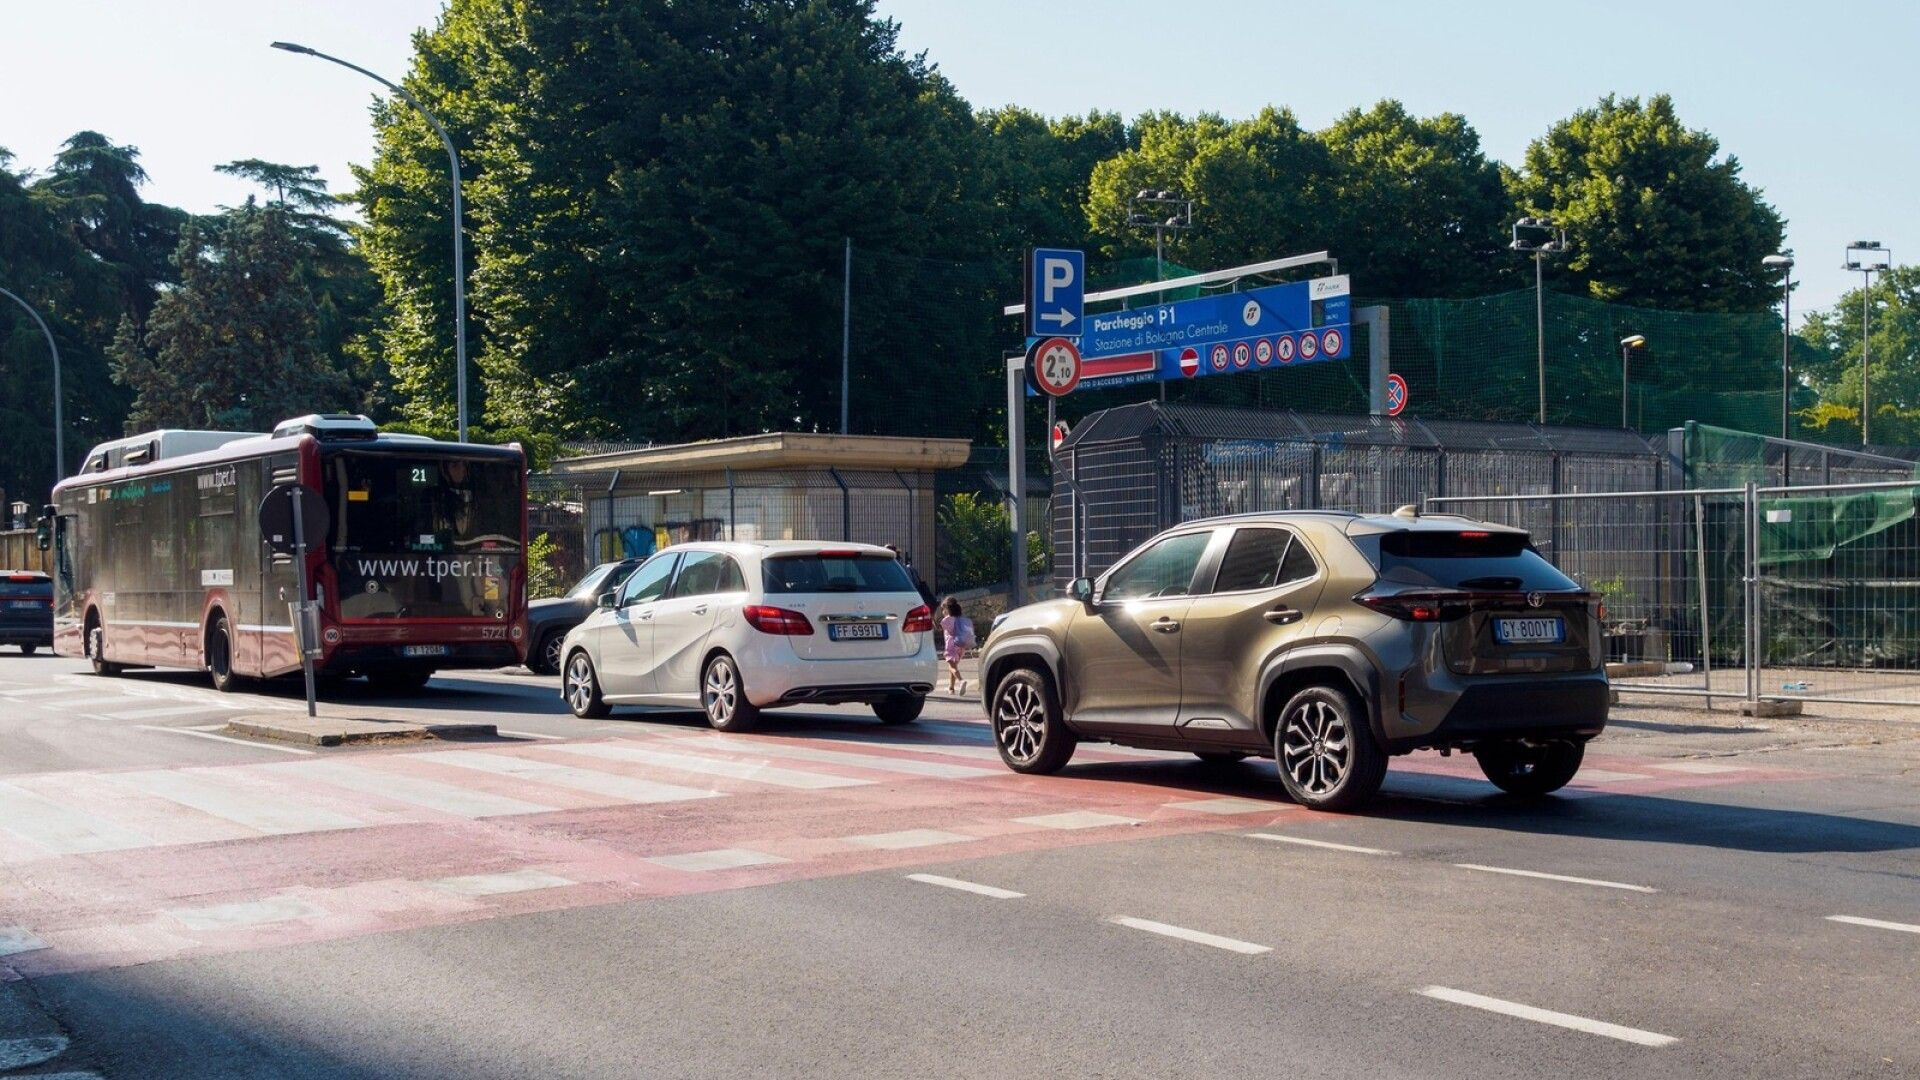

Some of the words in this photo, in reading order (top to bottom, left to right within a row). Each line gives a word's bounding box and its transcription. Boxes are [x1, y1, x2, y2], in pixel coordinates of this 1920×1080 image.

[1044, 257, 1075, 303] P
[1094, 311, 1154, 332] Parcheggio
[1159, 306, 1176, 326] P1
[1095, 339, 1132, 352] Stazione
[1135, 332, 1143, 346] di
[1145, 330, 1185, 345] Bologna
[1187, 321, 1228, 338] Centrale
[412, 469, 427, 482] 21
[358, 556, 493, 582] www.tper.it
[837, 625, 849, 637] FF
